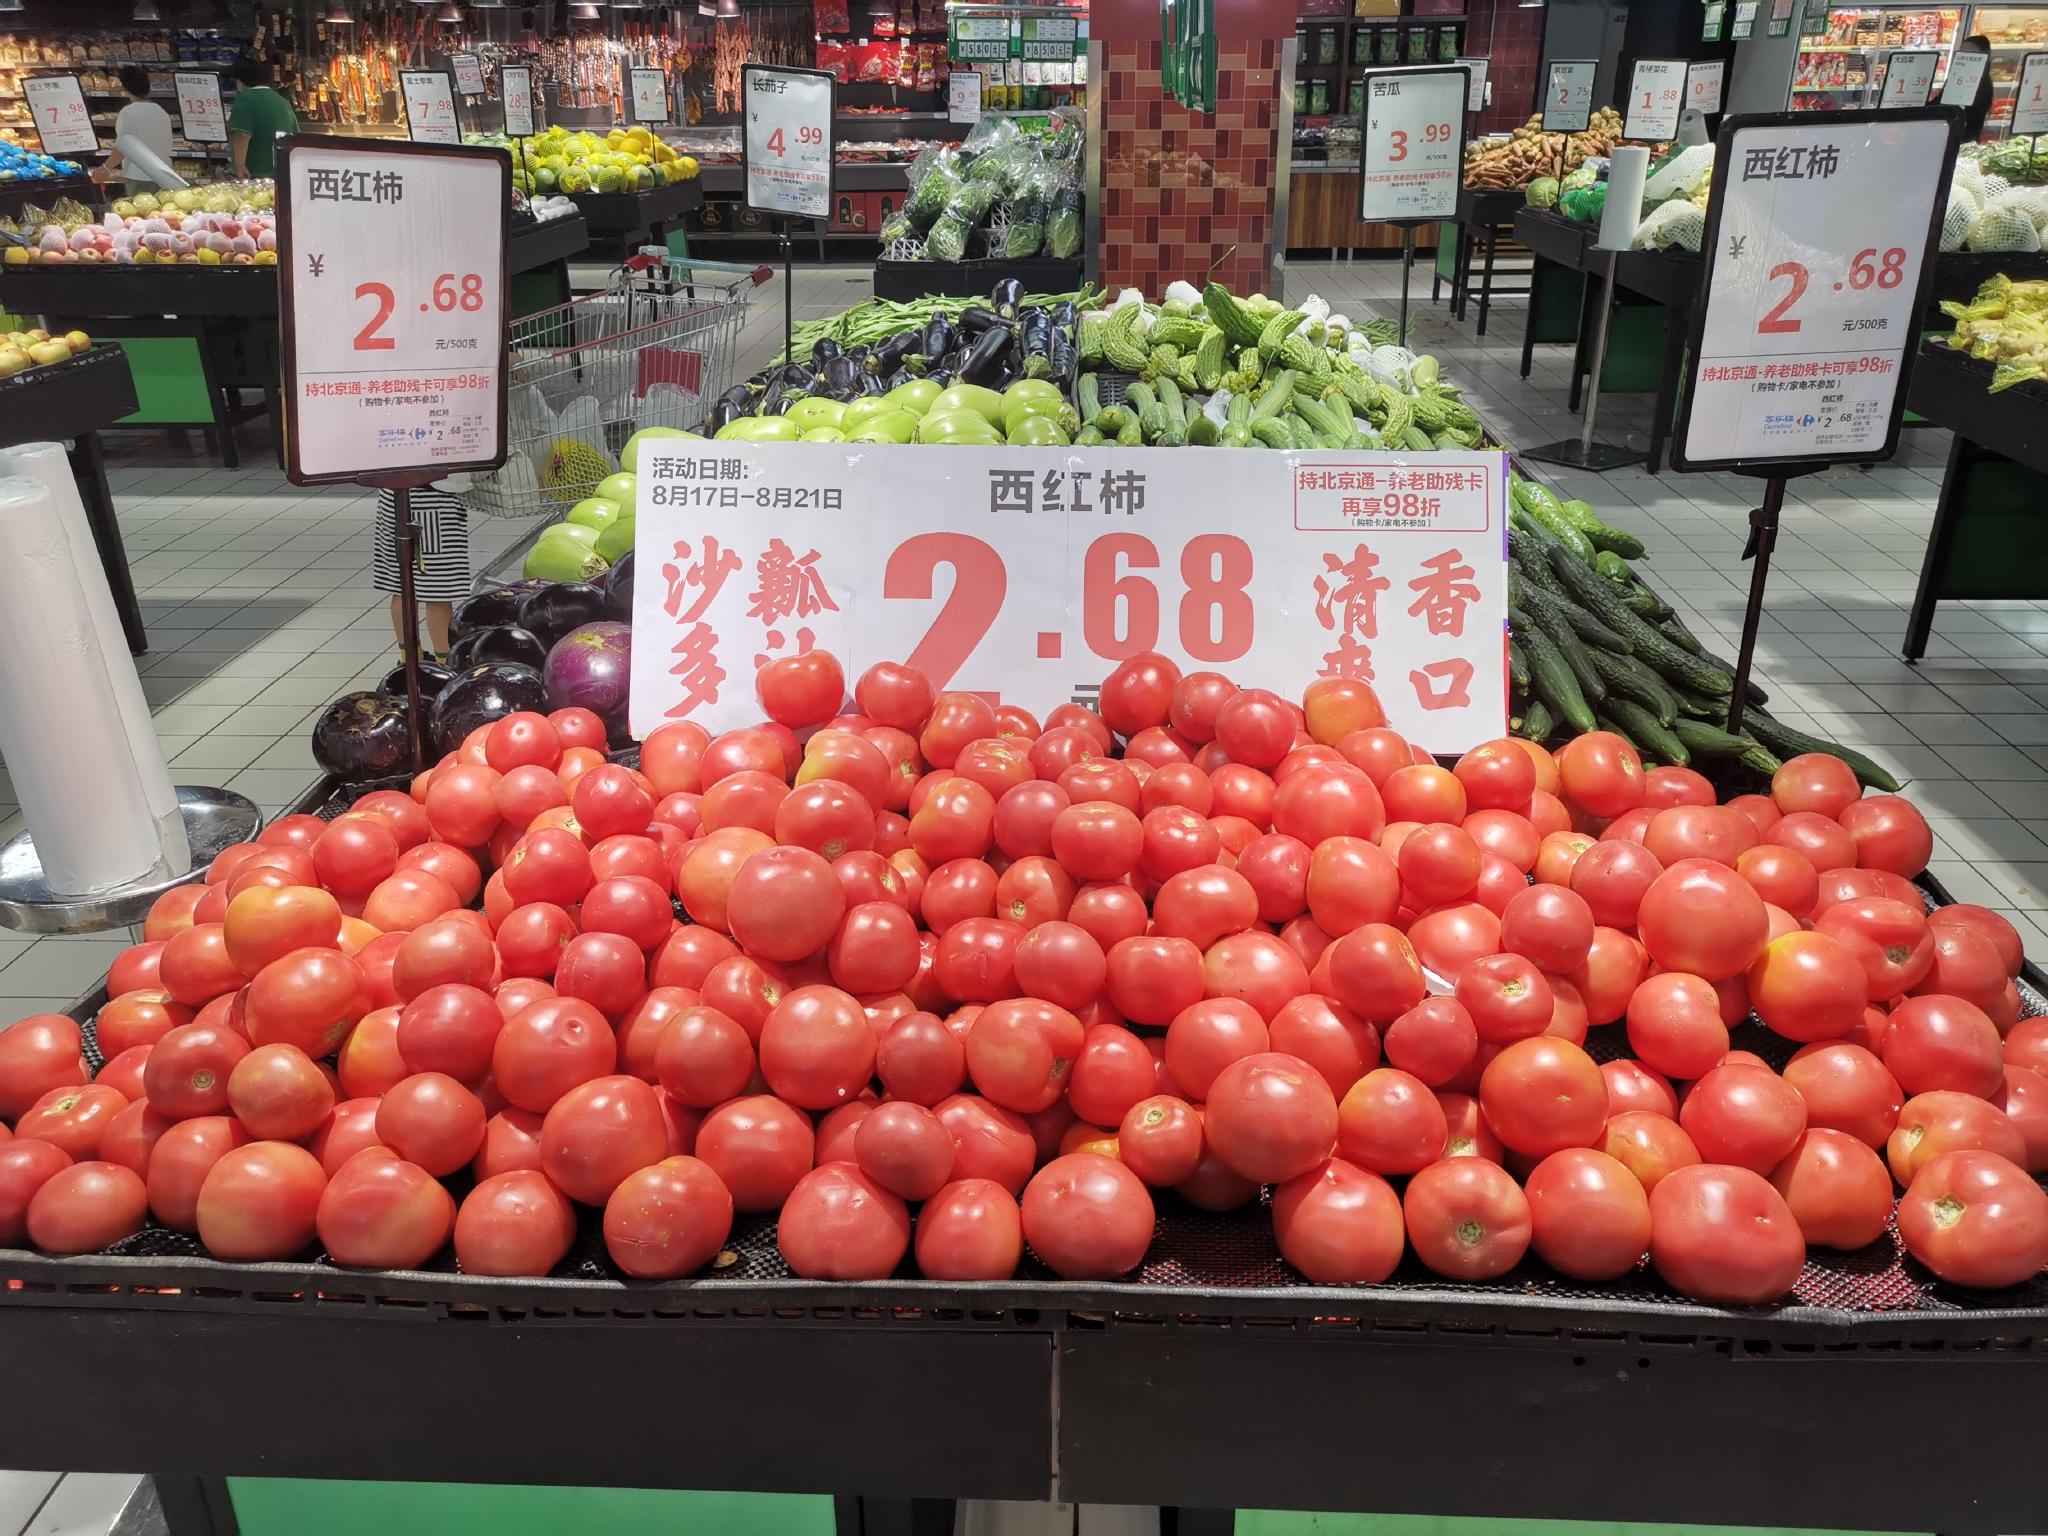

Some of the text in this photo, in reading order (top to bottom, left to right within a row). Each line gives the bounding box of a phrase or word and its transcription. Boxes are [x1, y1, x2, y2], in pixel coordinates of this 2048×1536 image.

[1893, 55, 1916, 64] 大白菜
[752, 77, 789, 94] 长茄子
[1373, 81, 1401, 97] 苦瓜
[1895, 76, 1928, 95] 1.39
[418, 99, 453, 120] 7.98
[1641, 89, 1678, 110] 1.88
[766, 126, 823, 158] 4.99
[1388, 123, 1452, 163] 3.99
[1742, 144, 1841, 182] 西红柿
[307, 168, 404, 205] 西红柿
[1758, 247, 1908, 334] 2.68
[353, 273, 484, 352] 2.68
[1842, 318, 1889, 332] 元/500克
[435, 338, 479, 351] 元/500克
[1702, 357, 1894, 382] 持北京通-养老助残卡可享98折
[305, 374, 490, 397] 持北京通-养老助残卡可享98折
[652, 457, 750, 481] 活动日期:
[1298, 471, 1484, 491] 持北京通-养老助残卡
[651, 485, 843, 511] 8月17日-8月21日
[989, 468, 1148, 516] 西红柿
[1341, 493, 1441, 518] 再享98折
[883, 531, 1255, 705] 2.68
